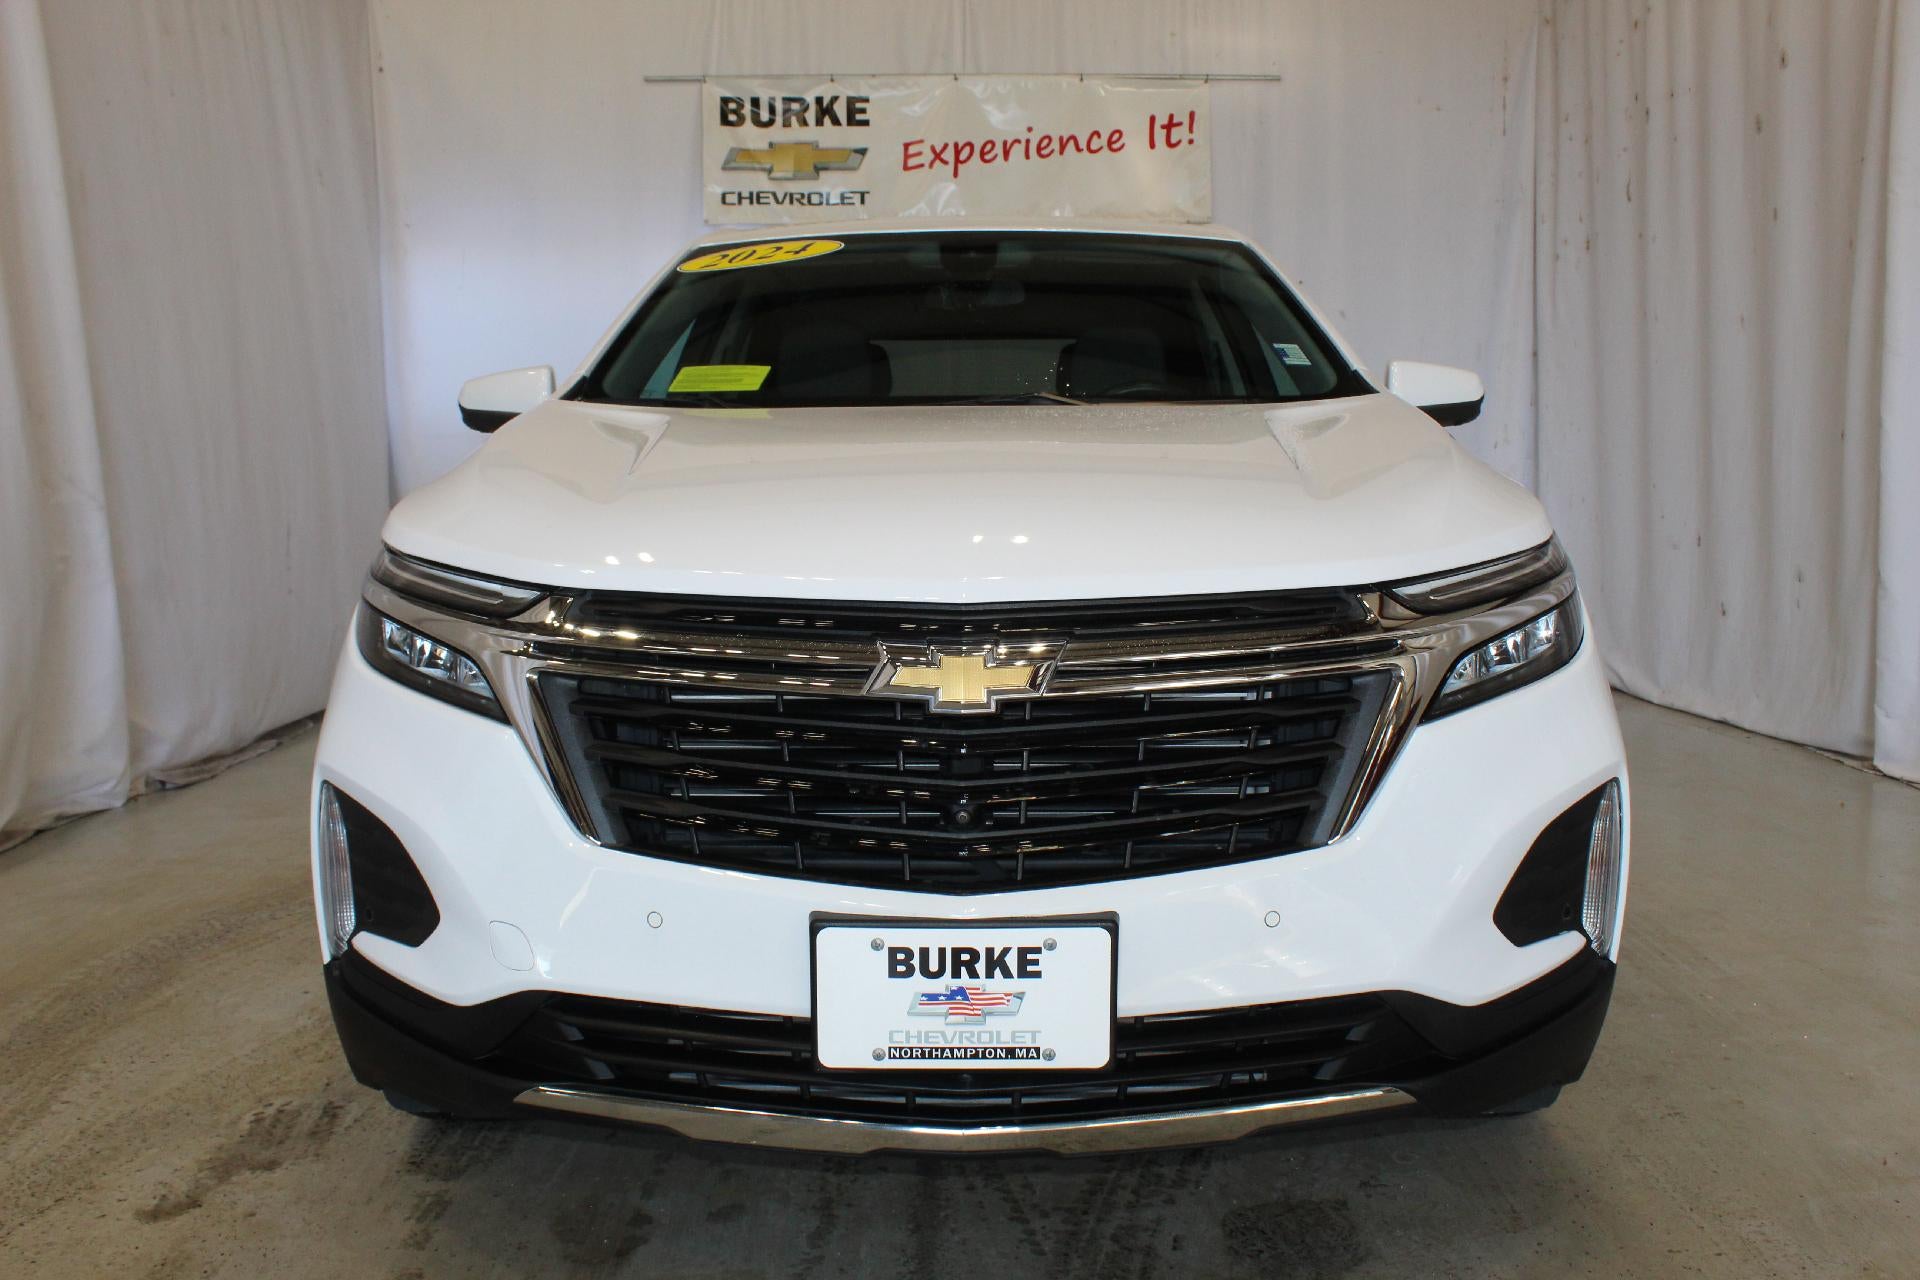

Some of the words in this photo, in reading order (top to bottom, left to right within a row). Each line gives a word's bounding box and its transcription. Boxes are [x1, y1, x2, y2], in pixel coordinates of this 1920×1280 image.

[720, 96, 870, 127] BURKE
[902, 127, 1125, 178] Experience
[1148, 111, 1196, 150] It!
[721, 190, 870, 206] CHEVROLET
[700, 241, 817, 269] 2024
[888, 946, 1042, 979] BURKE
[889, 1030, 1041, 1045] CHEVROLET
[890, 1048, 1011, 1060] NORTHAMPTON,
[1016, 1048, 1038, 1059] MA
